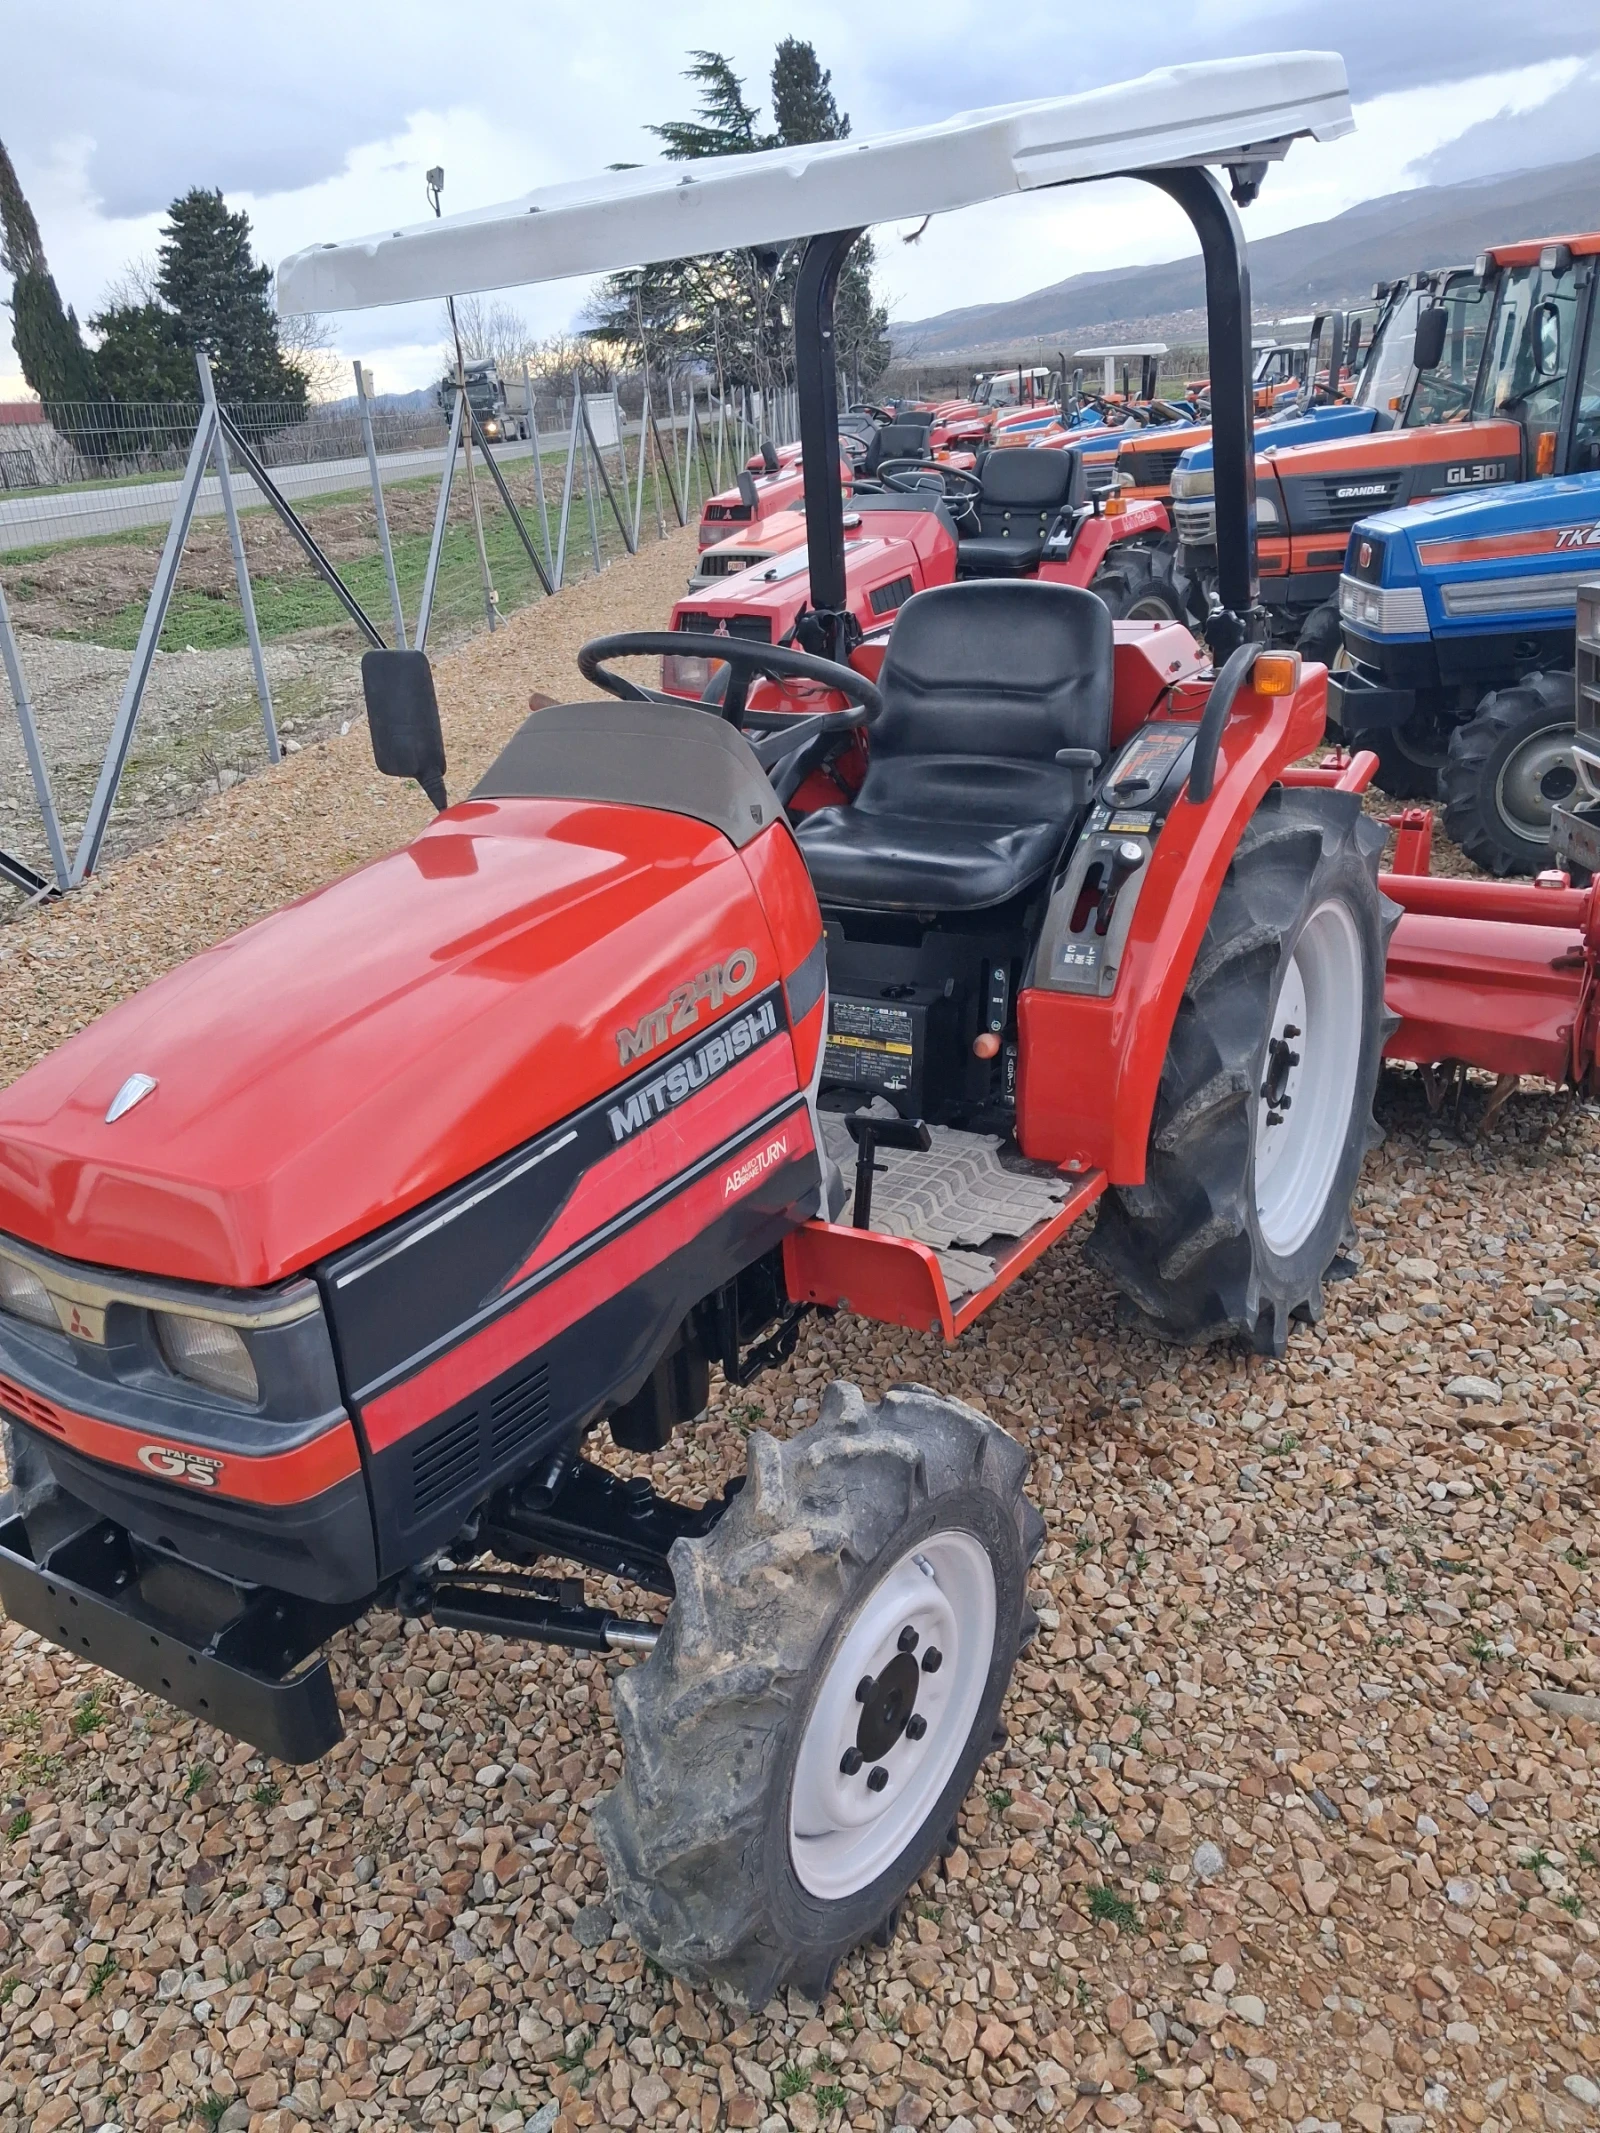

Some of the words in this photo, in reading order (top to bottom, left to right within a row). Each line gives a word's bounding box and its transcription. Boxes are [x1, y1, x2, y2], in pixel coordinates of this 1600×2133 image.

[1337, 485, 1388, 498] GRANDEL
[1447, 464, 1506, 484] GL301
[615, 947, 758, 1068] MT240
[608, 1000, 777, 1141] MITSUBISHI
[741, 1158, 757, 1175] AUTO
[755, 1135, 787, 1172] TURN
[137, 1445, 215, 1486] GS
[165, 1448, 225, 1468] PALCEED
